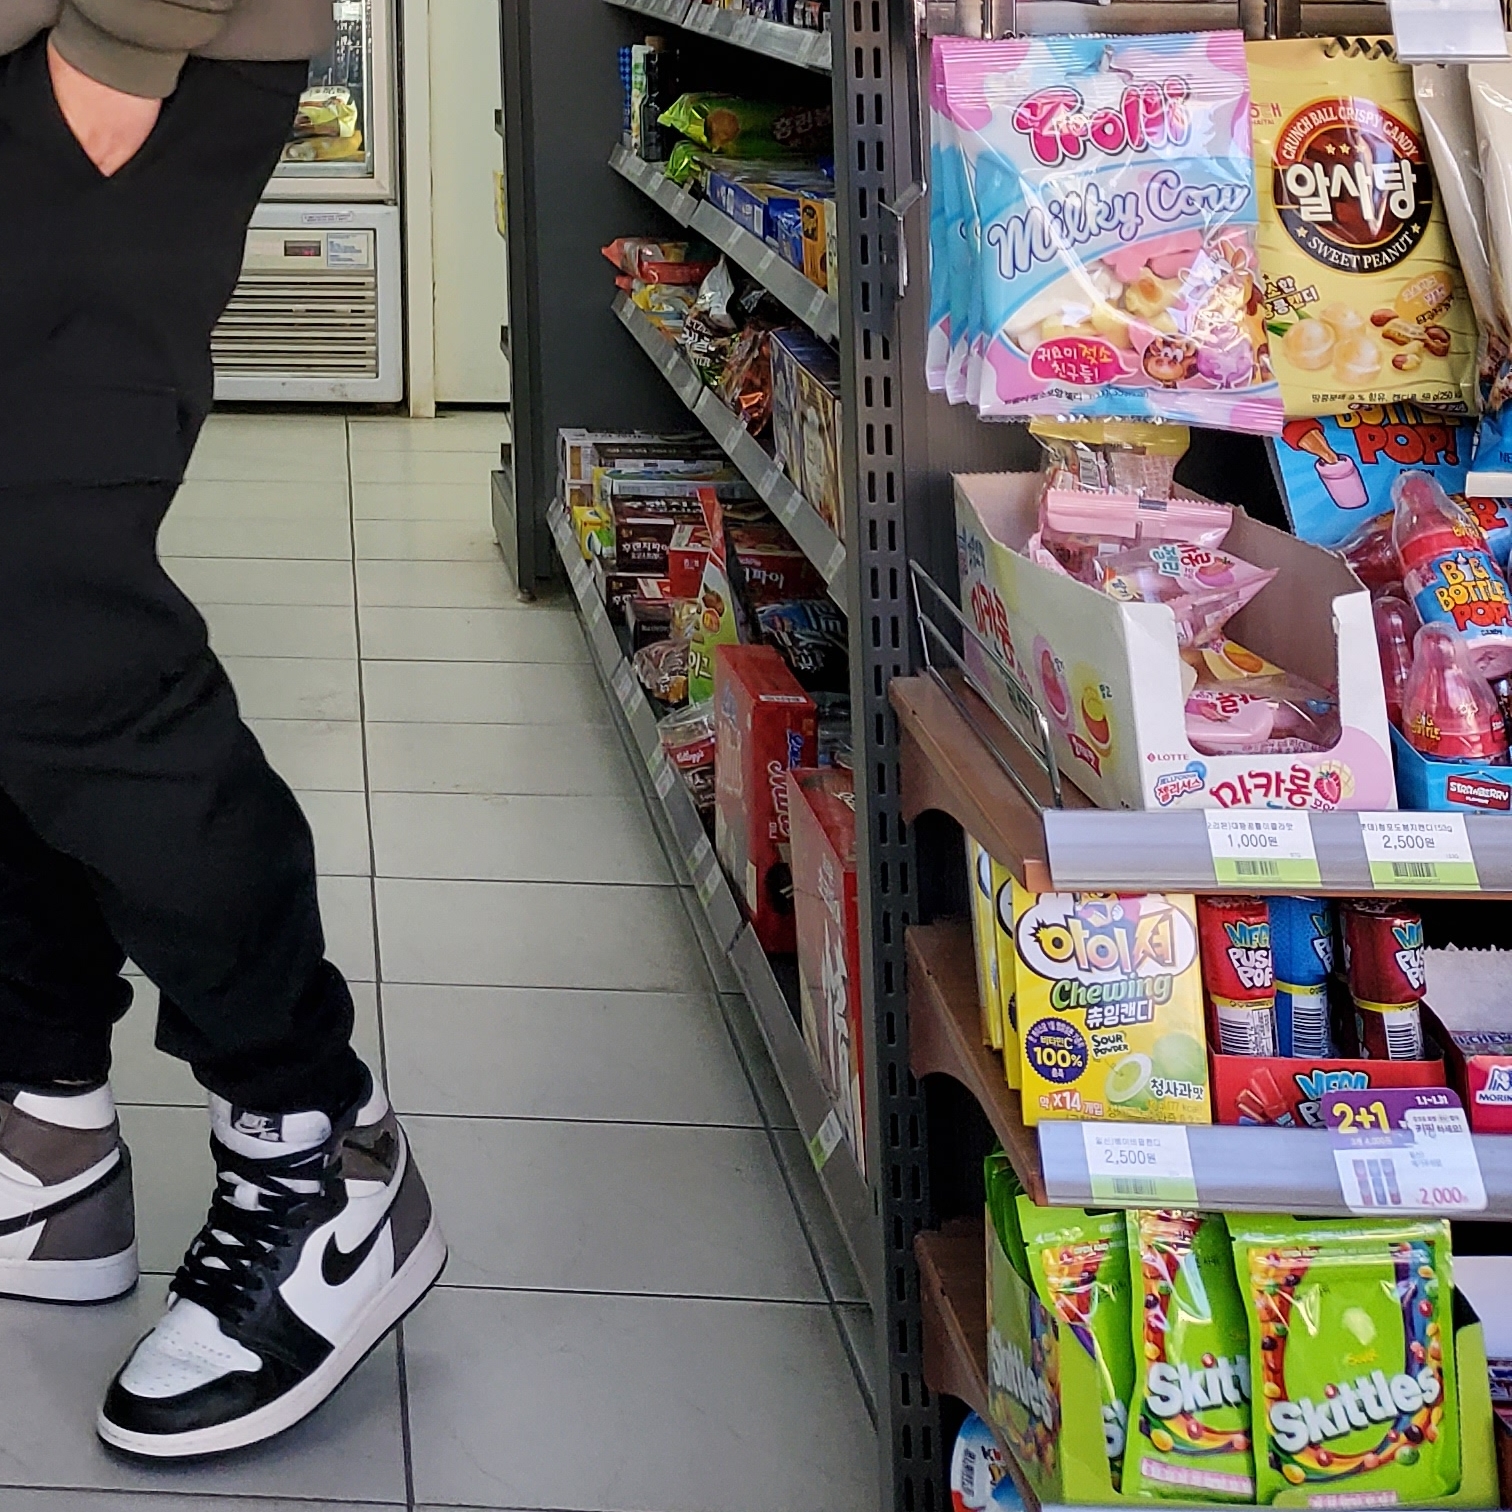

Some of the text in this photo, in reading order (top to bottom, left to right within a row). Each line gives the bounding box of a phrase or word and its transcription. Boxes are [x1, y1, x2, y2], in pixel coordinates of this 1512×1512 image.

[1013, 74, 1191, 168] Trolli
[1281, 105, 1420, 160] CRUNCH BALL CRISPY CANDY
[1286, 159, 1417, 223] 알사탕
[987, 168, 1252, 281] Milky Cow
[1306, 231, 1413, 270] SWEET PEANUT
[1051, 361, 1100, 384] 친구들!
[1353, 423, 1461, 467] POP!
[1437, 578, 1510, 612] BOTTLE
[1156, 753, 1189, 762] LOTTE
[1208, 764, 1313, 810] 마카롱
[1227, 834, 1279, 849] 1,000원
[1381, 834, 1436, 851] 2,500원
[1032, 907, 1180, 975] 아이셔
[1049, 972, 1174, 1011] Chewing
[1086, 999, 1154, 1029] 츄잉캔디
[1033, 1046, 1083, 1068] 100%
[1091, 1034, 1123, 1047] SOUR
[1092, 1042, 1129, 1057] POWDER
[1150, 1078, 1204, 1100] 청사과맛
[1332, 1101, 1391, 1135] 2+1
[1104, 1149, 1157, 1165] 2,500원
[1420, 1186, 1463, 1207] 2,000
[1269, 1364, 1443, 1457] Skittles
